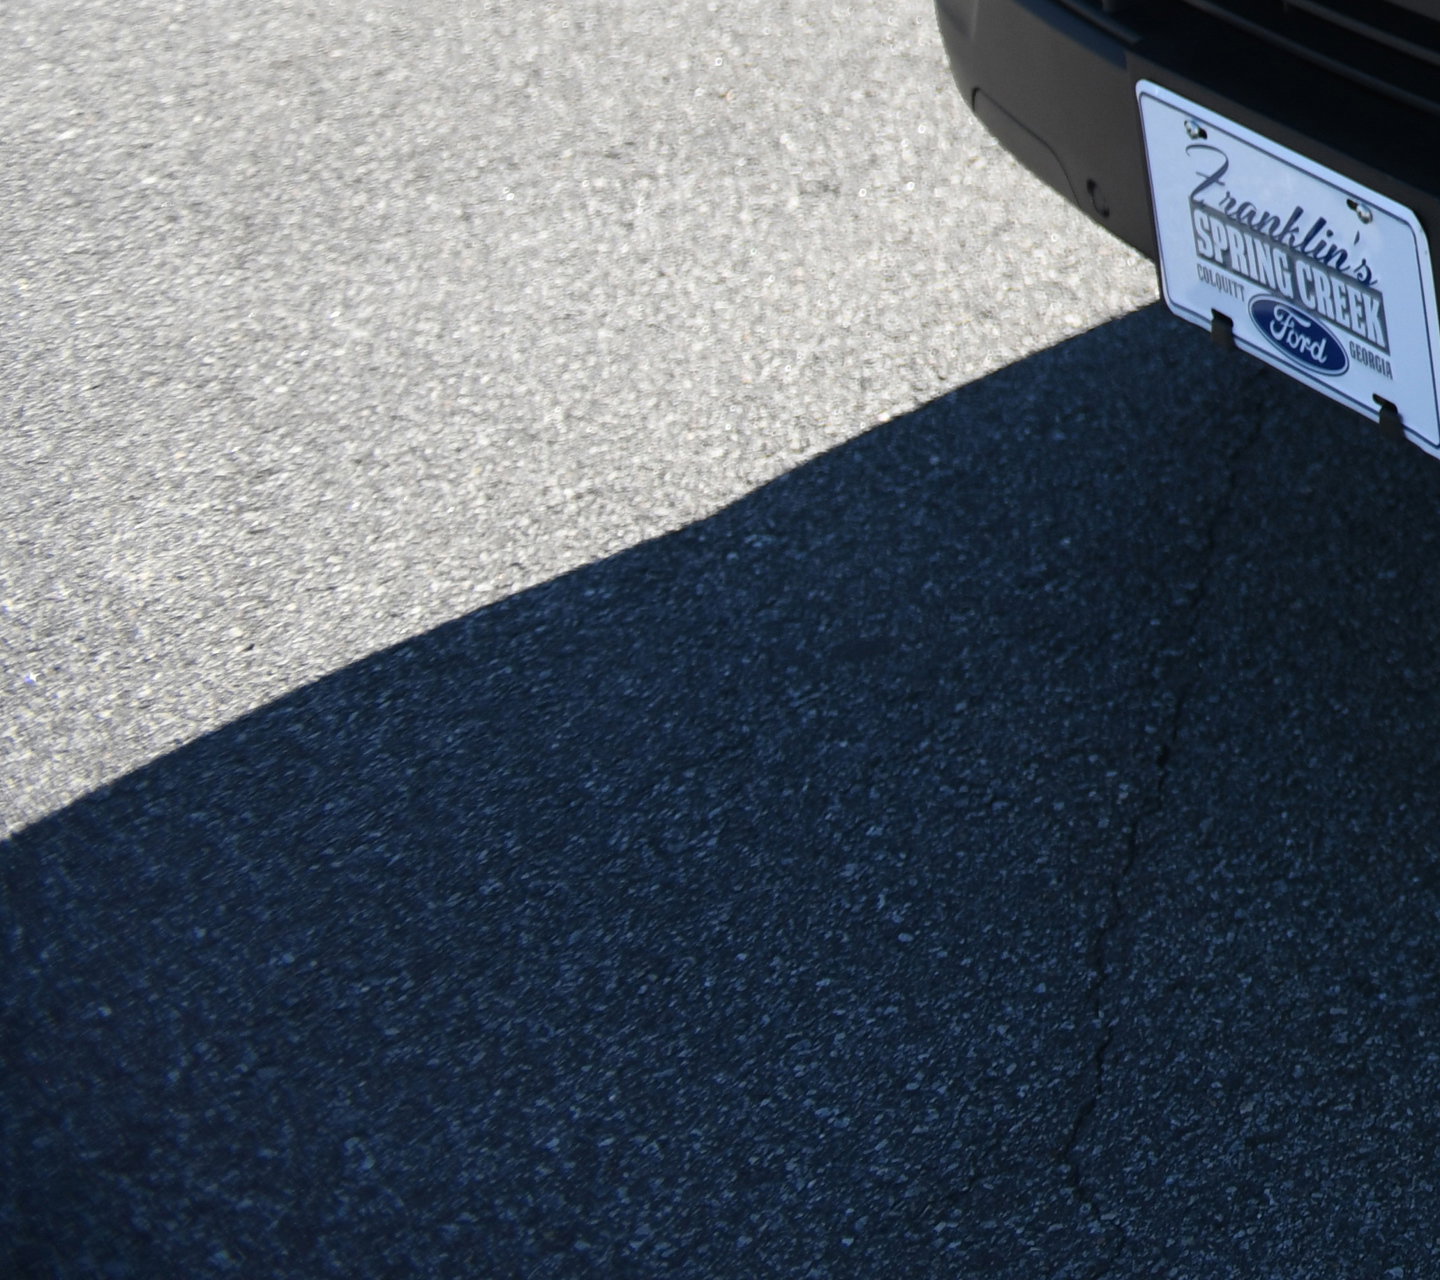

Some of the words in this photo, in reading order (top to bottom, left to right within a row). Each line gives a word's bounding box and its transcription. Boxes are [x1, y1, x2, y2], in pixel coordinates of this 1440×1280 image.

[1185, 142, 1378, 288] Franklin's
[1193, 209, 1294, 300] SPRING
[1295, 259, 1388, 352] CREEK
[1197, 263, 1245, 302] COLQUITT
[1269, 303, 1328, 364] Ford
[1349, 340, 1393, 381] GEORGIA
